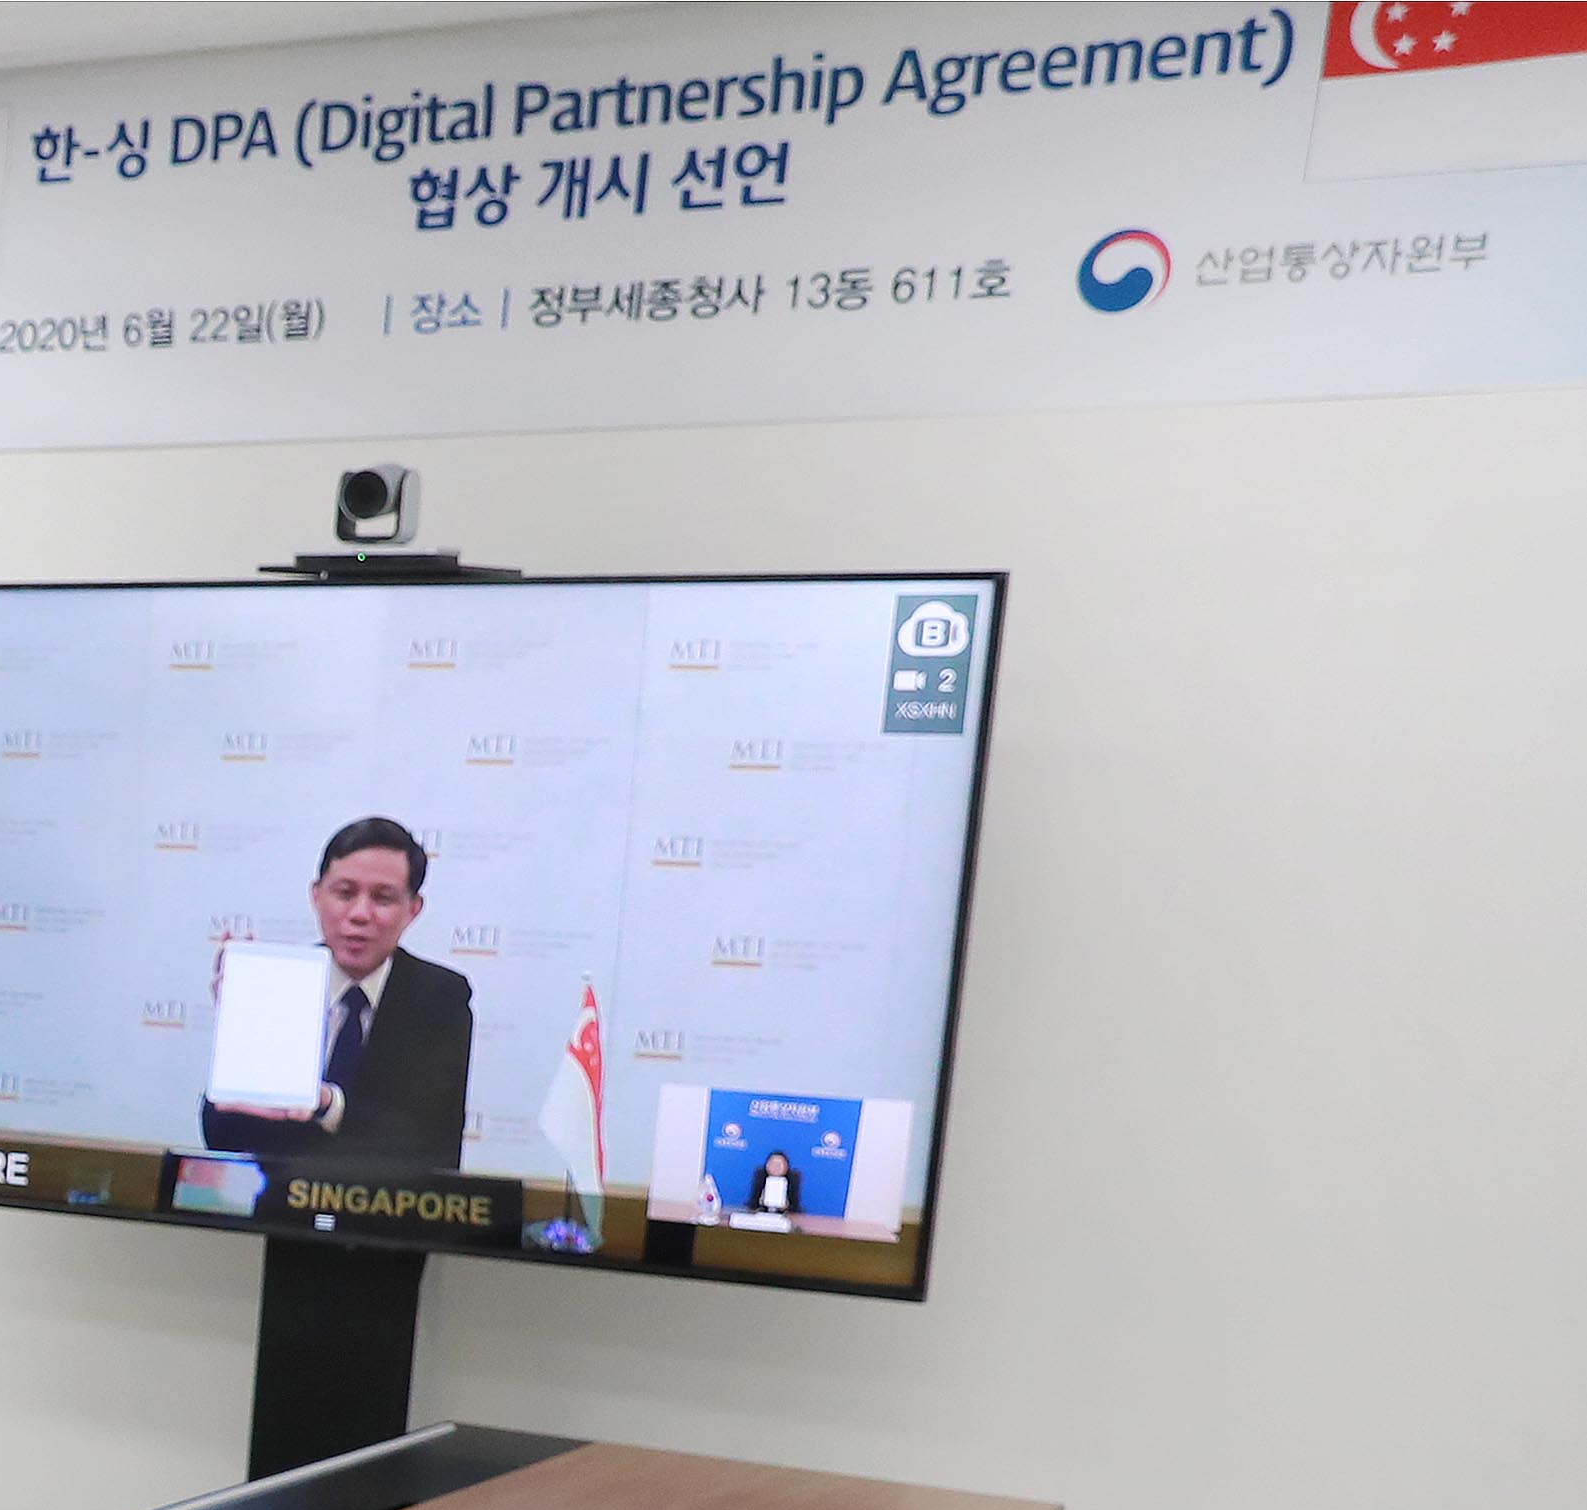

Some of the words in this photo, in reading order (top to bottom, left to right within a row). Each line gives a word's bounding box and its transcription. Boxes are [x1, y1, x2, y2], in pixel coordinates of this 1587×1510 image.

[32, 118, 150, 184] 한-싱
[170, 109, 278, 166] DPA
[295, 83, 494, 168] (Digital
[514, 52, 865, 136] Partnership
[881, 8, 1295, 118] Agreement)
[410, 163, 522, 231] 협상
[537, 152, 651, 219] 개시
[672, 141, 790, 211] 선언
[1195, 231, 1490, 287] 산업통상자원부
[122, 307, 175, 349] 6월
[189, 299, 326, 344] 22일(월)
[411, 292, 482, 335] 장소
[529, 274, 765, 328] 정부세종청사
[788, 268, 873, 312] 13동
[890, 258, 1012, 305] 611호
[938, 669, 957, 692] 2
[287, 1178, 493, 1227] SINGAPORE
